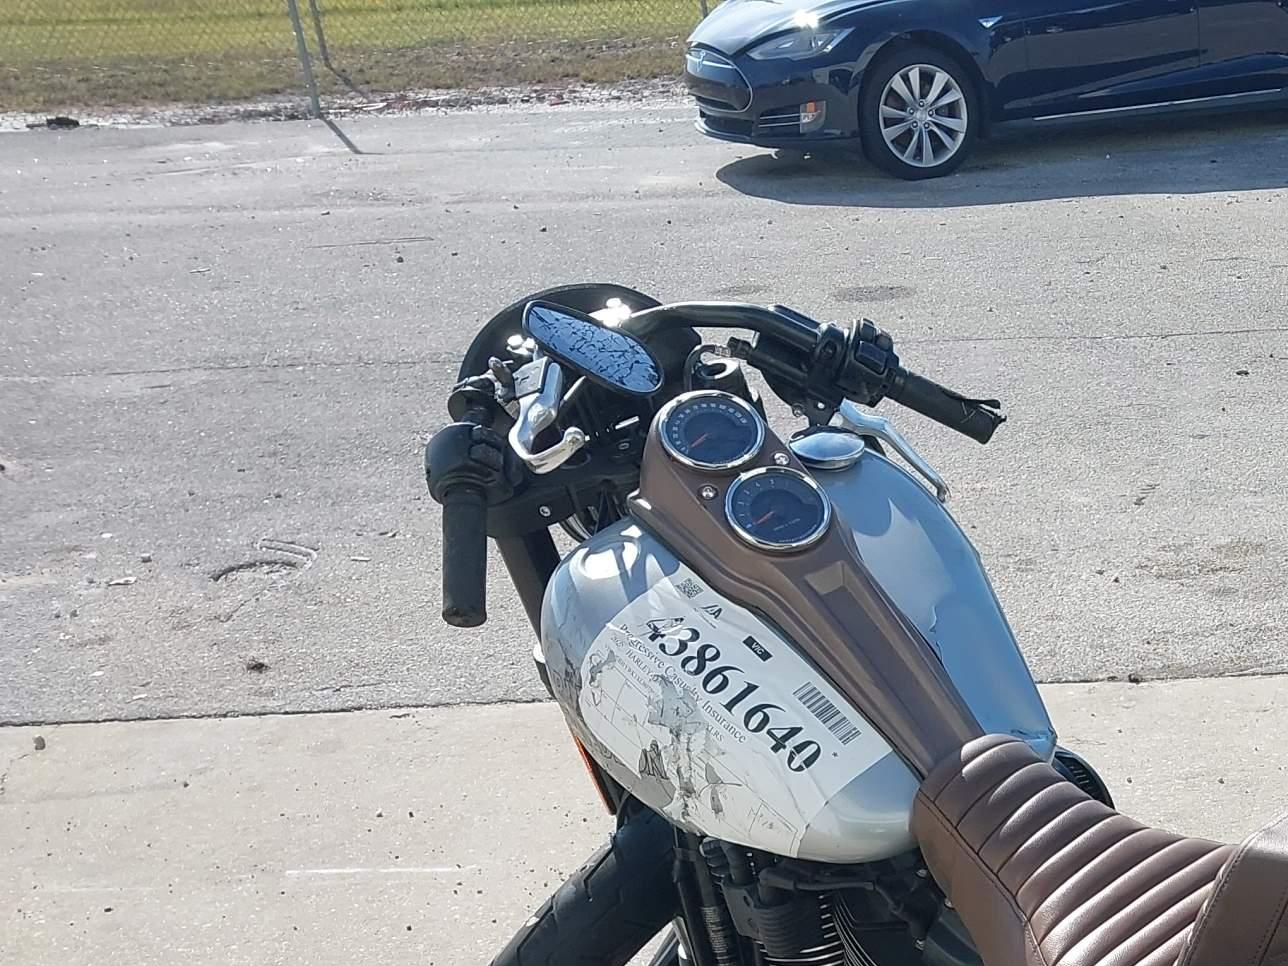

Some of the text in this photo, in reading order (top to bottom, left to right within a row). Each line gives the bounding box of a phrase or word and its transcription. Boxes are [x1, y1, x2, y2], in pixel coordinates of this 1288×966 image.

[620, 623, 665, 669] Progressive
[701, 699, 747, 744] Insurance
[646, 616, 822, 773] 43861640
